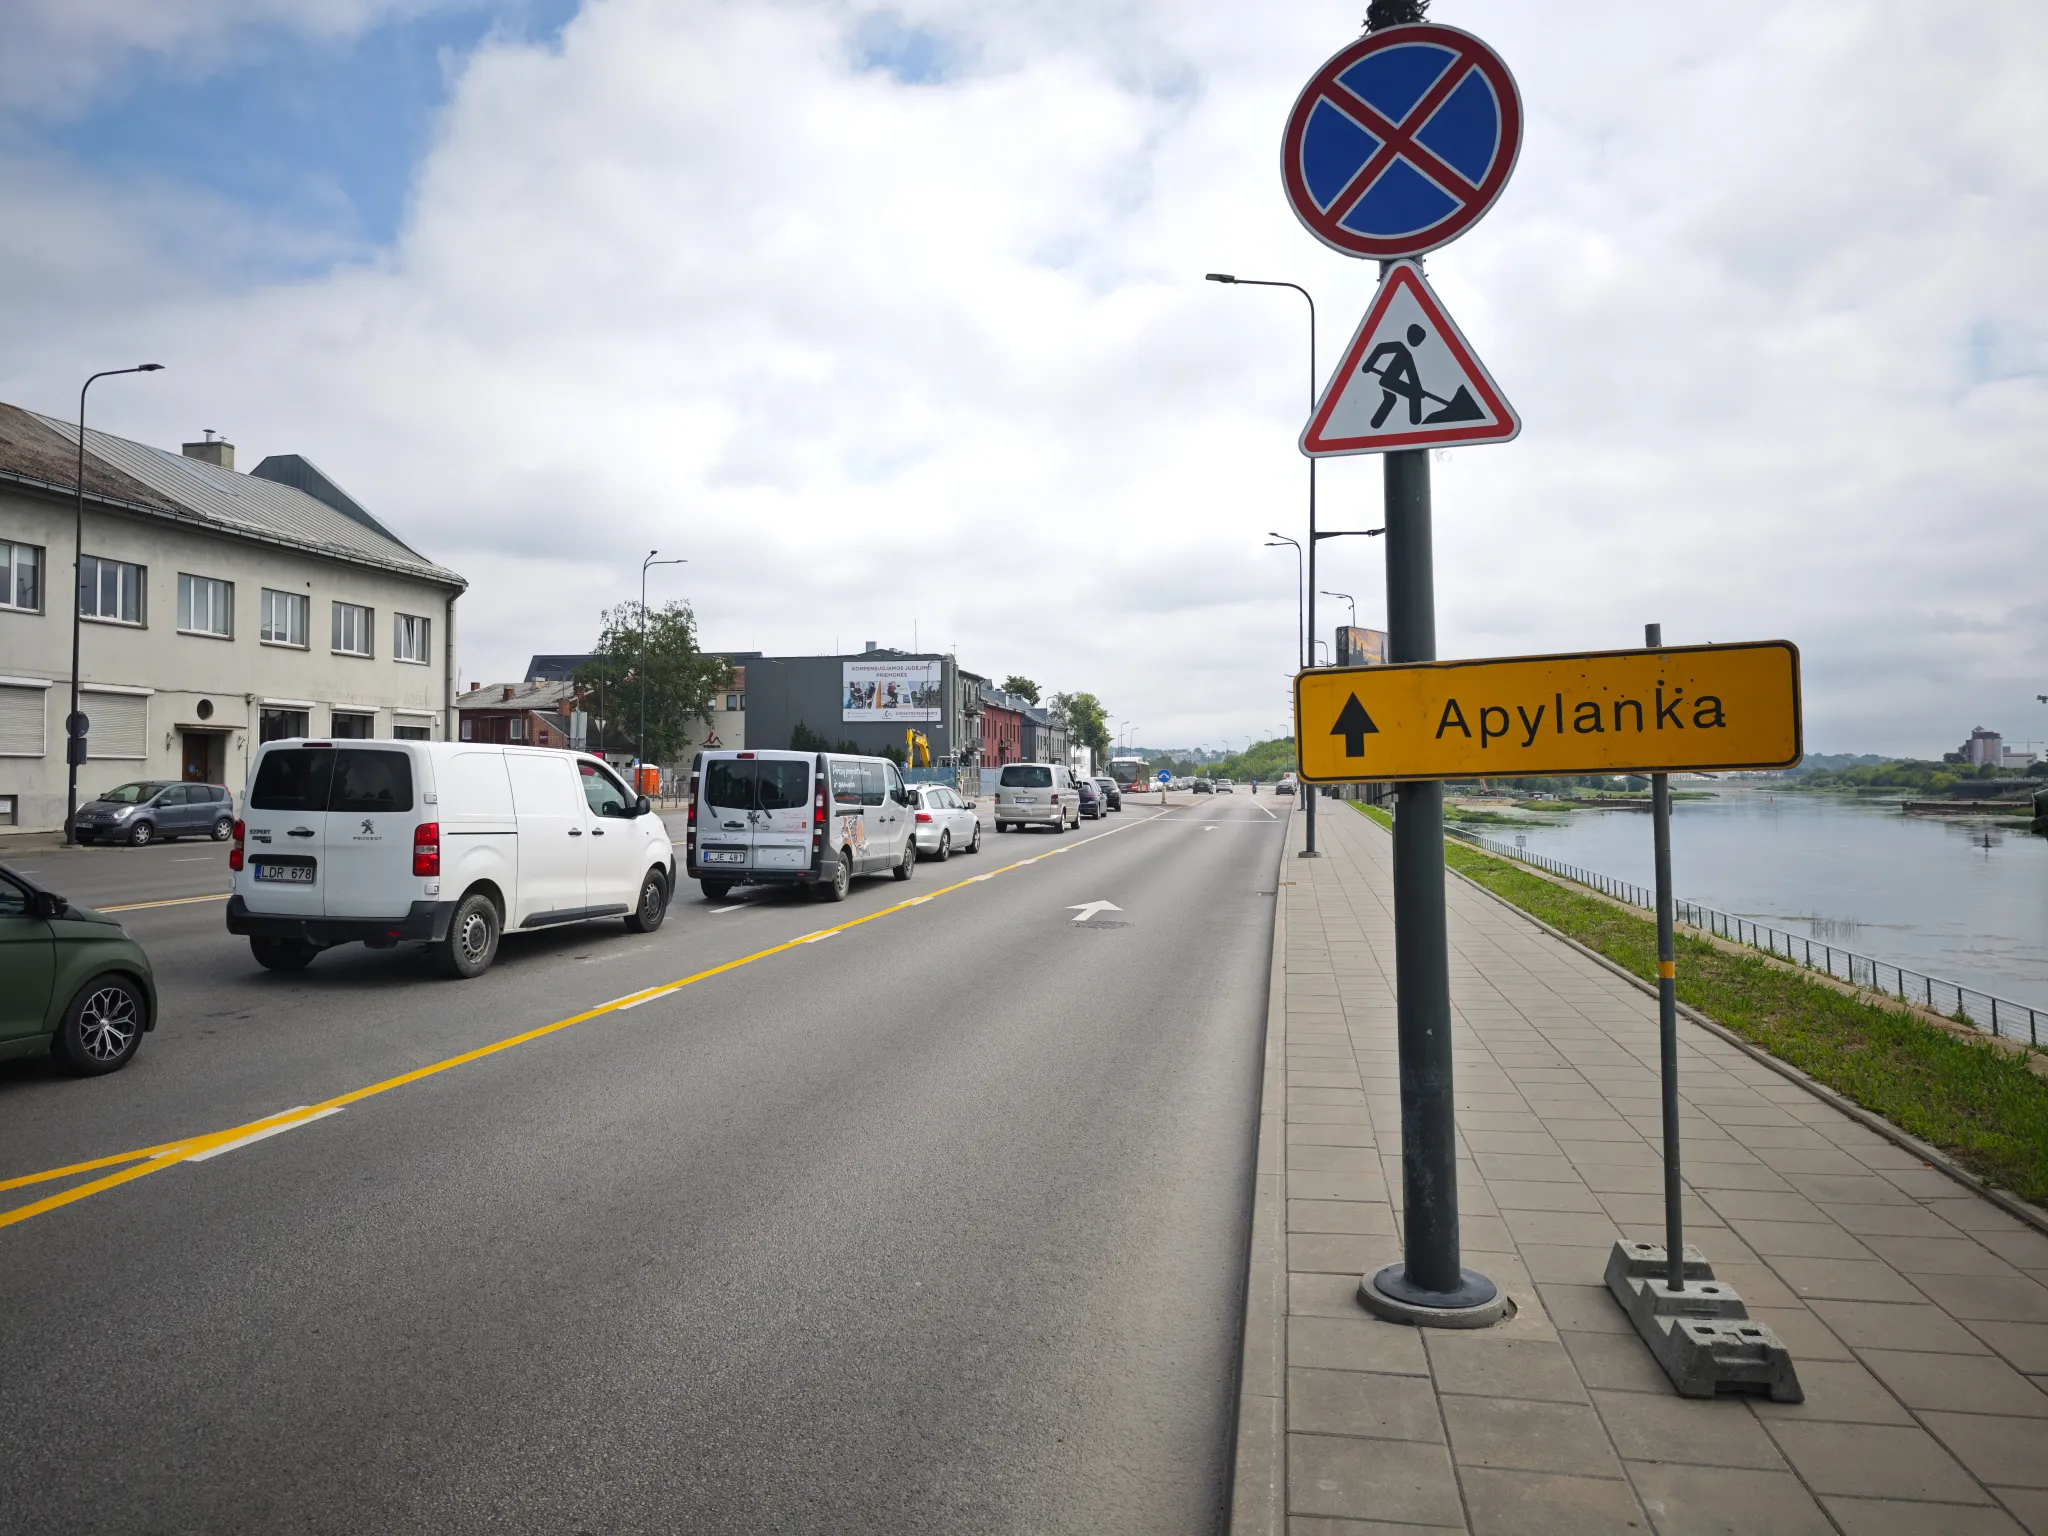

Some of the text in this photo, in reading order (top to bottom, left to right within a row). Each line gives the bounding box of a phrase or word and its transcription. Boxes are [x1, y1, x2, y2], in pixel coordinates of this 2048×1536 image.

[1435, 687, 1727, 748] Apylanka
[708, 853, 725, 861] LJE
[261, 866, 312, 880] LDR 678
